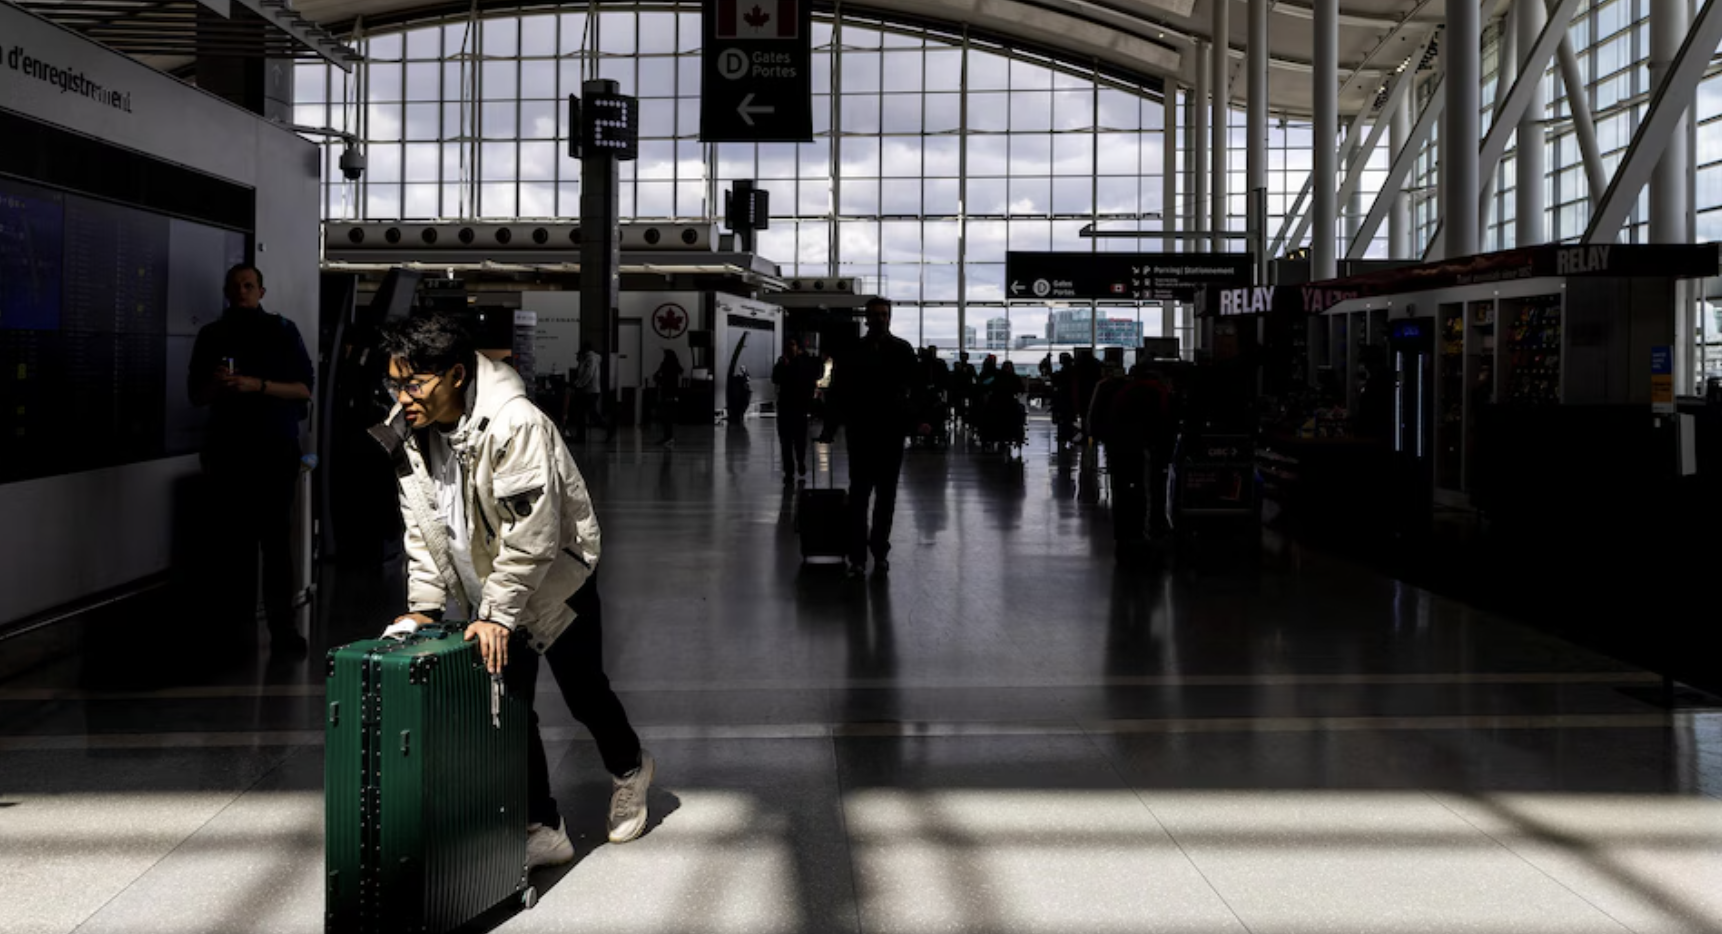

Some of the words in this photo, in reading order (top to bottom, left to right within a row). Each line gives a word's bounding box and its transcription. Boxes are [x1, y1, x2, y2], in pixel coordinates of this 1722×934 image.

[752, 51, 791, 64] Gates
[752, 65, 797, 78] Portes
[1556, 245, 1611, 275] RELAY
[1219, 285, 1275, 316] RELAY
